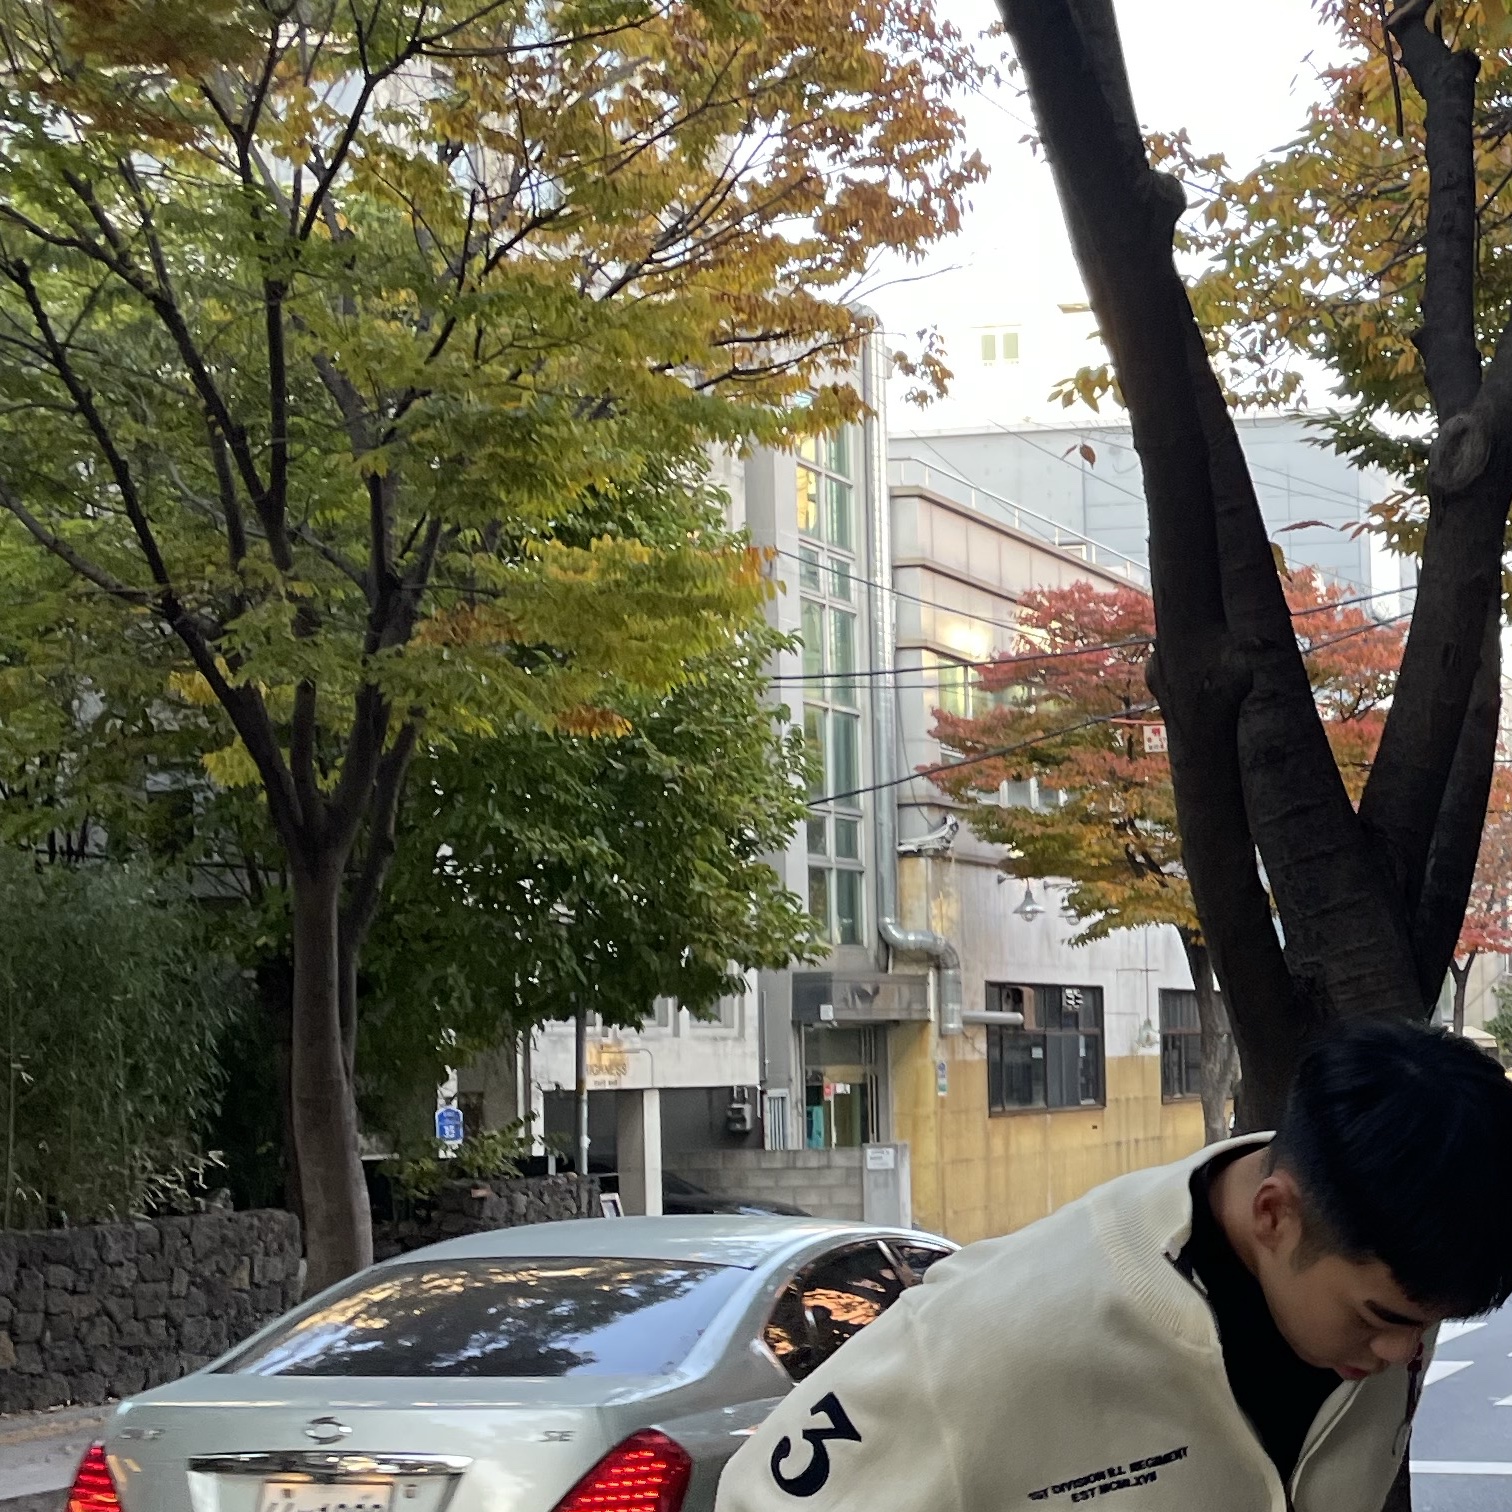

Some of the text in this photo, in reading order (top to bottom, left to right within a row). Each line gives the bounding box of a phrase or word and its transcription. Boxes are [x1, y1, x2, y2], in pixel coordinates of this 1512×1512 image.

[770, 1391, 862, 1498] 3
[1051, 1469, 1107, 1495] DIVISION
[1129, 1445, 1189, 1473] REGIMENT
